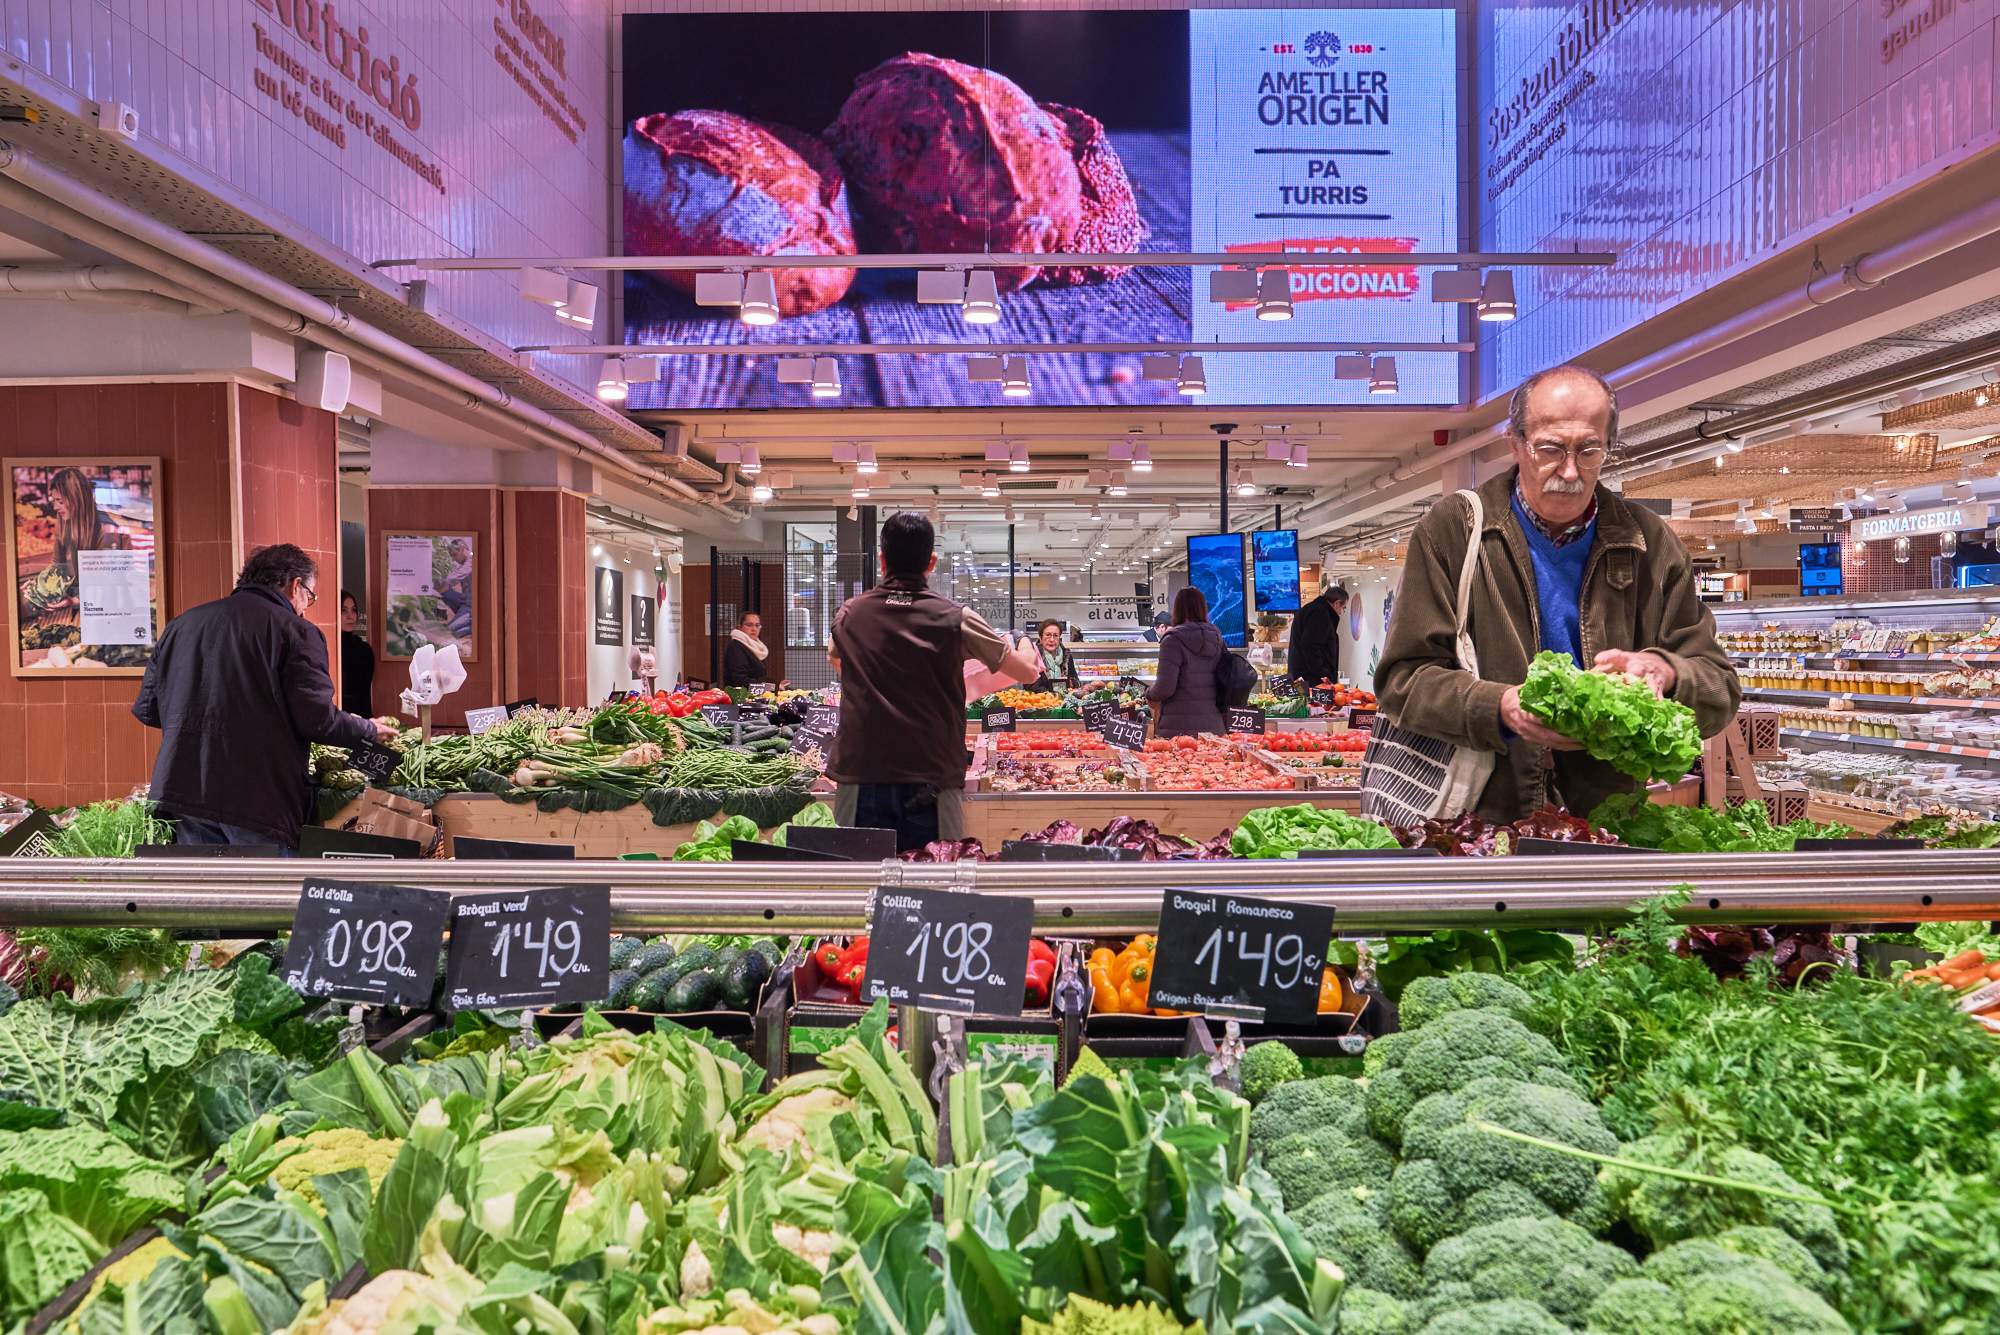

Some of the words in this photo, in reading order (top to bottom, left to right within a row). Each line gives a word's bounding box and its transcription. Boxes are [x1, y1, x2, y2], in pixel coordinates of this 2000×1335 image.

[1273, 44, 1296, 54] EST.
[252, 22, 308, 86] Tornar
[310, 75, 321, 97] a
[323, 79, 344, 113] fer
[346, 100, 363, 130] de
[255, 0, 421, 131] utrició
[1257, 71, 1388, 94] AMETLLER
[254, 68, 279, 101] un
[281, 79, 303, 117] bé
[304, 105, 346, 150] comú
[1257, 94, 1389, 126] ORIGEN
[1308, 160, 1341, 179] PA
[1279, 185, 1368, 205] TURRIS
[1289, 272, 1411, 293] DICIONAL
[1862, 510, 1962, 537] FORMATGERIA
[1088, 608, 1100, 620] el
[308, 887, 324, 899] Col
[325, 888, 353, 902] d'olla
[882, 895, 923, 910] Coliflor
[458, 902, 500, 917] Bròquil
[1226, 899, 1294, 920] Romanesco
[328, 919, 413, 973] 0'98
[492, 917, 581, 977] 1'49
[572, 963, 590, 973] €/u.
[906, 922, 992, 984] 1'98
[987, 974, 1006, 986] €/u.
[1194, 928, 1303, 989] 1'49
